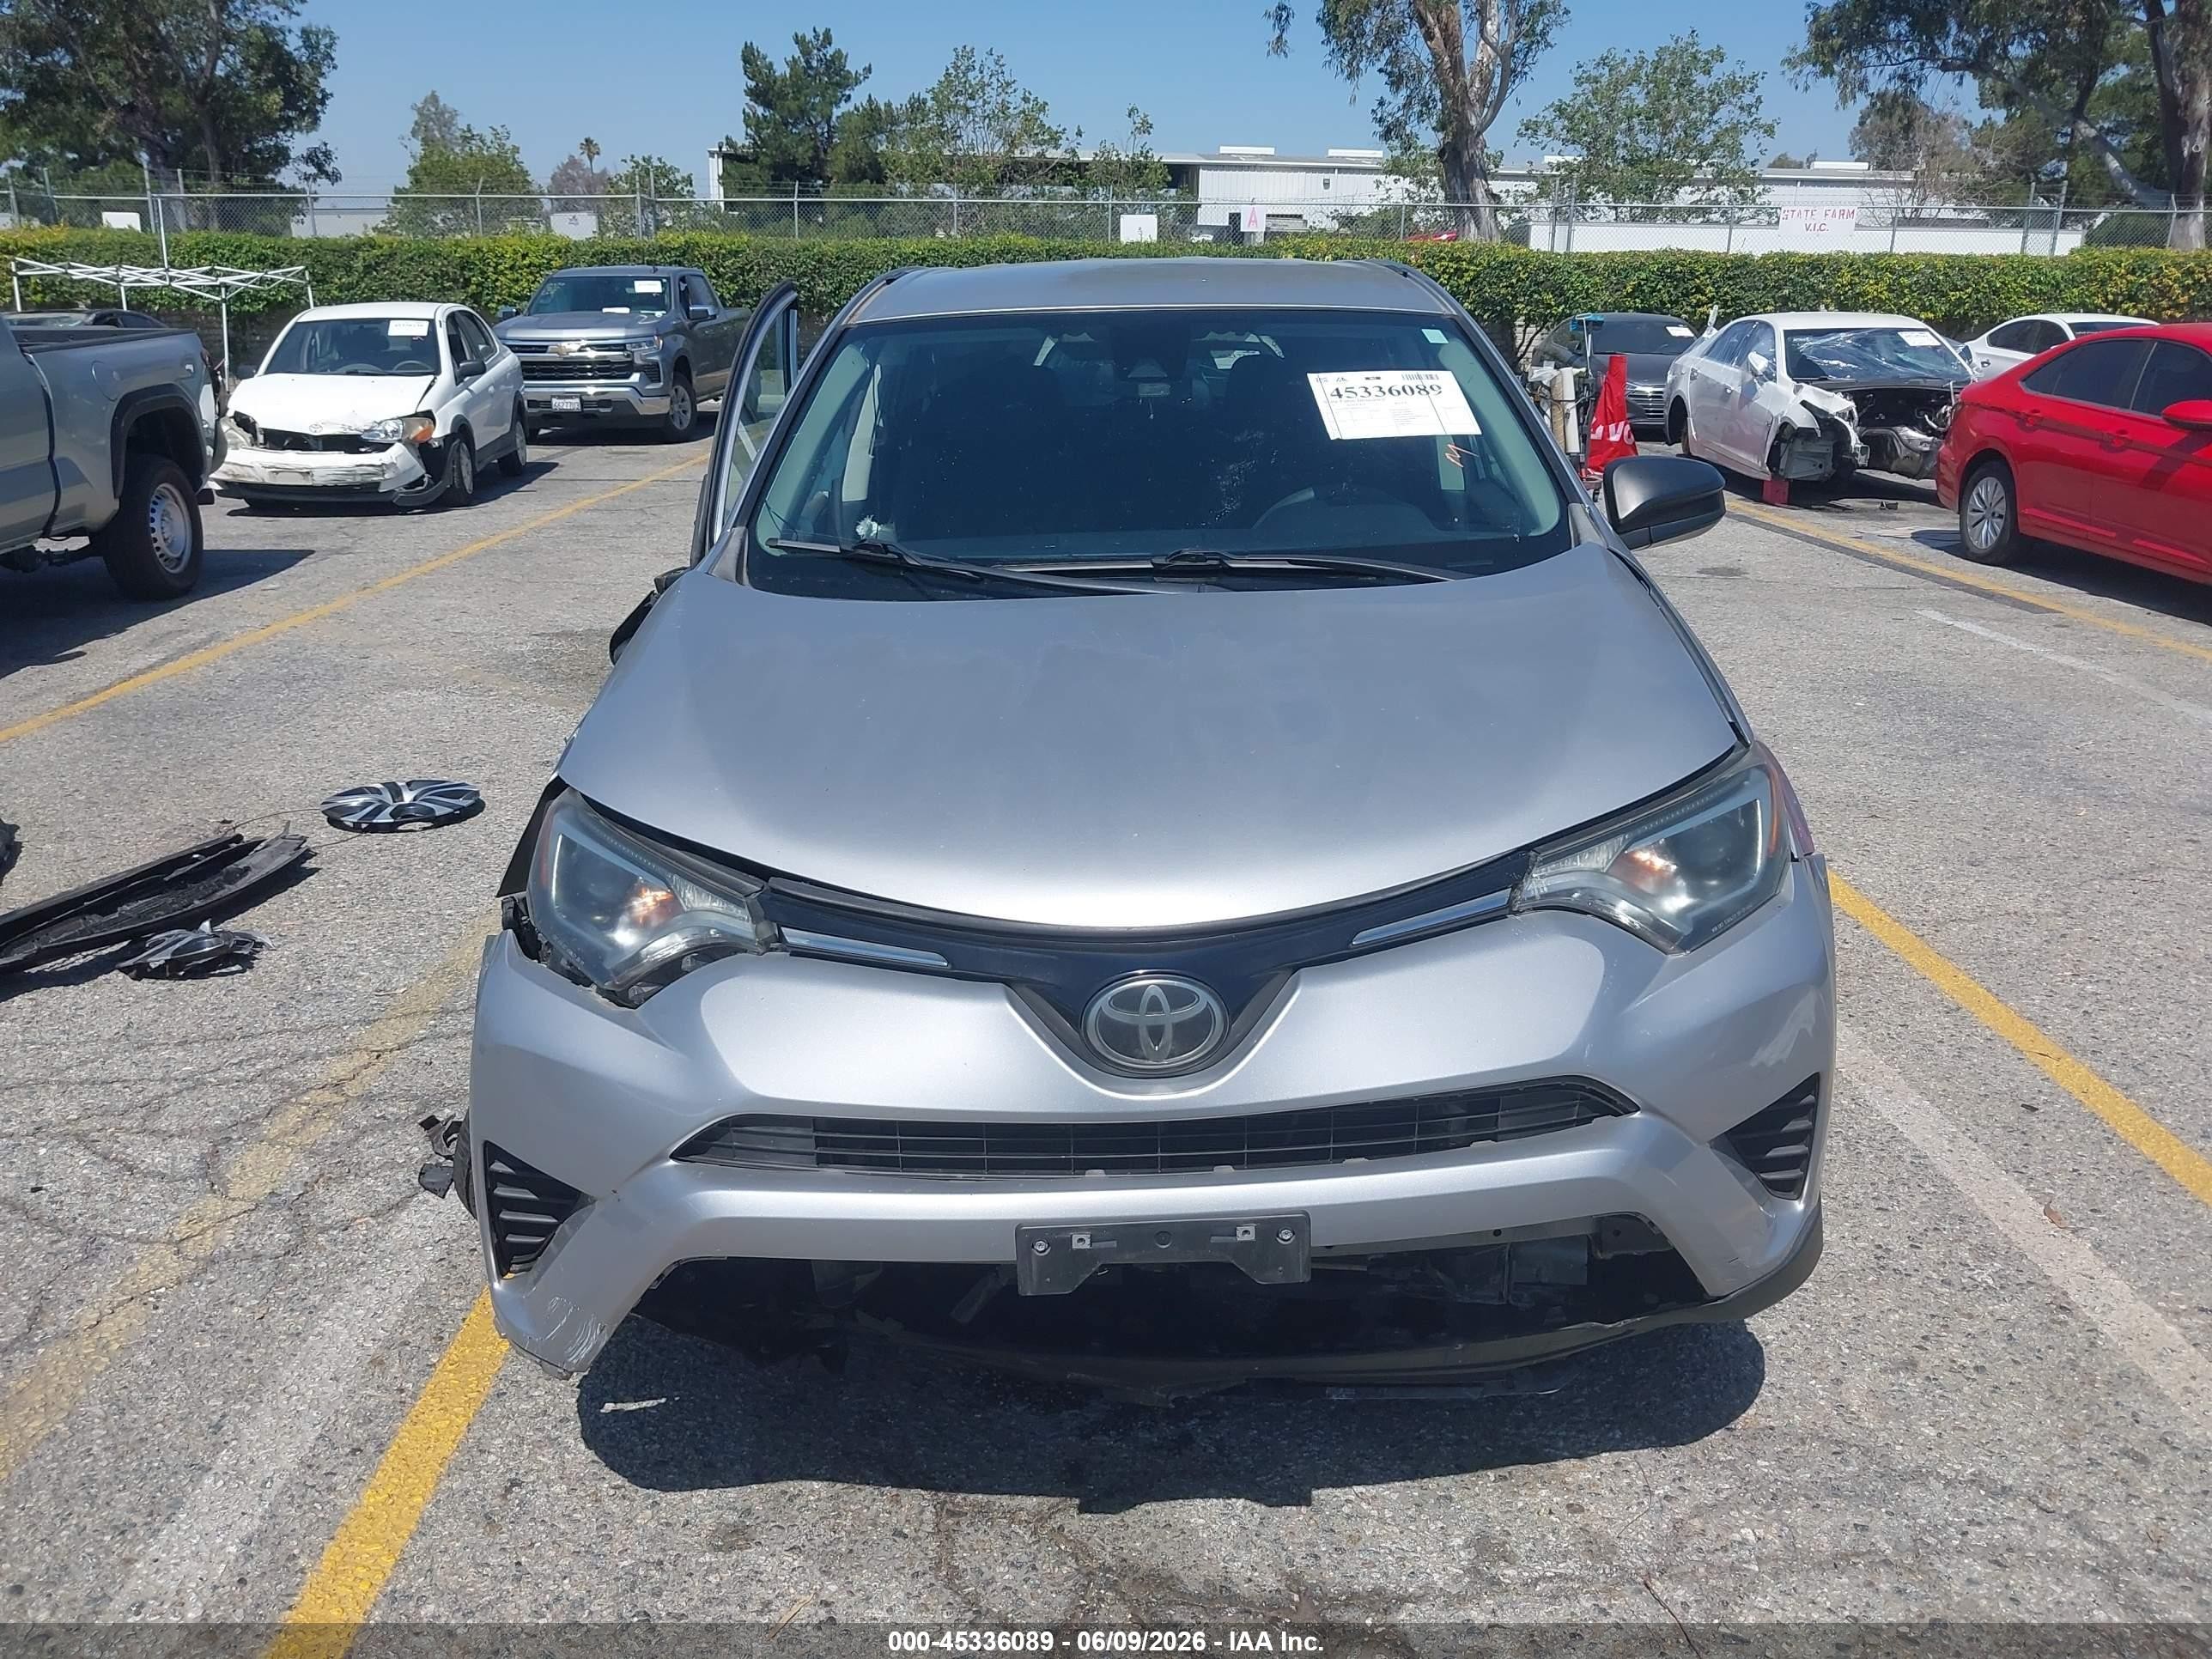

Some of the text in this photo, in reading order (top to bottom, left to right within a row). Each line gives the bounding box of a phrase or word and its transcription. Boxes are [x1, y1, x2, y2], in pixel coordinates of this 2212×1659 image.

[1248, 206, 1258, 228] A
[1782, 209, 1855, 221] STATE FARM
[1804, 222, 1829, 232] V.I.C.
[1330, 384, 1443, 399] 45336089
